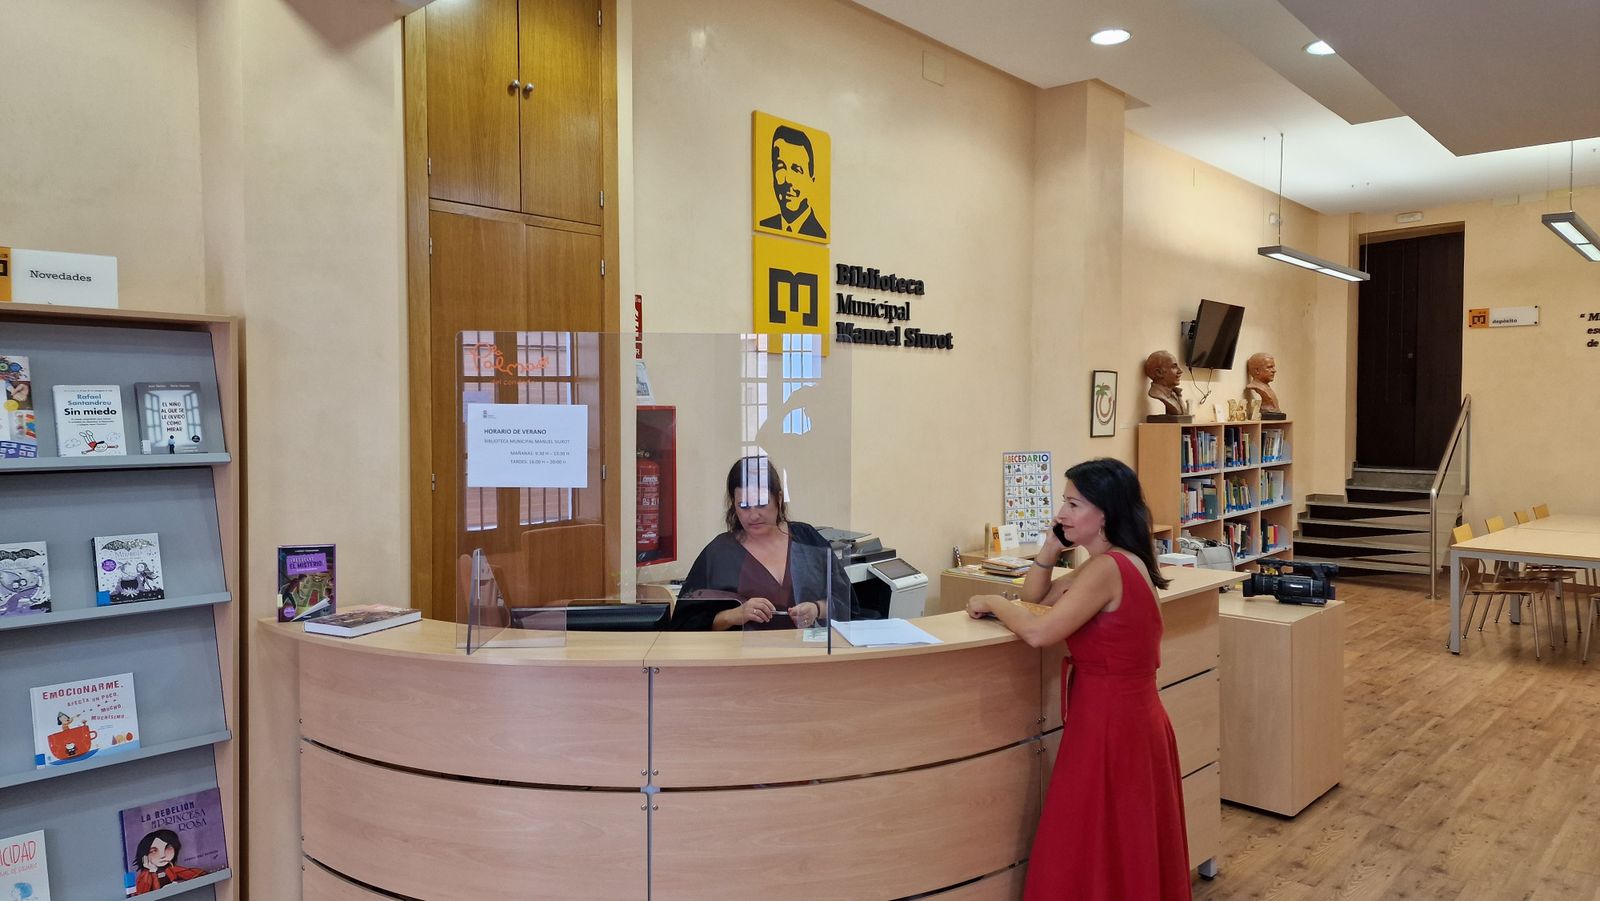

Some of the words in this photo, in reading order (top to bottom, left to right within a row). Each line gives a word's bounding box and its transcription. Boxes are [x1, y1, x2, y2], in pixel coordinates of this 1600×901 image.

[30, 270, 92, 282] Novedades
[836, 263, 925, 295] Biblioteca
[836, 293, 910, 323] Municipal
[836, 322, 901, 346] Manuel
[904, 327, 953, 350] Siurot
[1587, 339, 1600, 347] de
[64, 407, 81, 416] Sin
[84, 407, 117, 416] miedo
[141, 814, 151, 823] LA
[155, 801, 195, 819] REBELIÓN
[178, 818, 207, 832] ROSA
